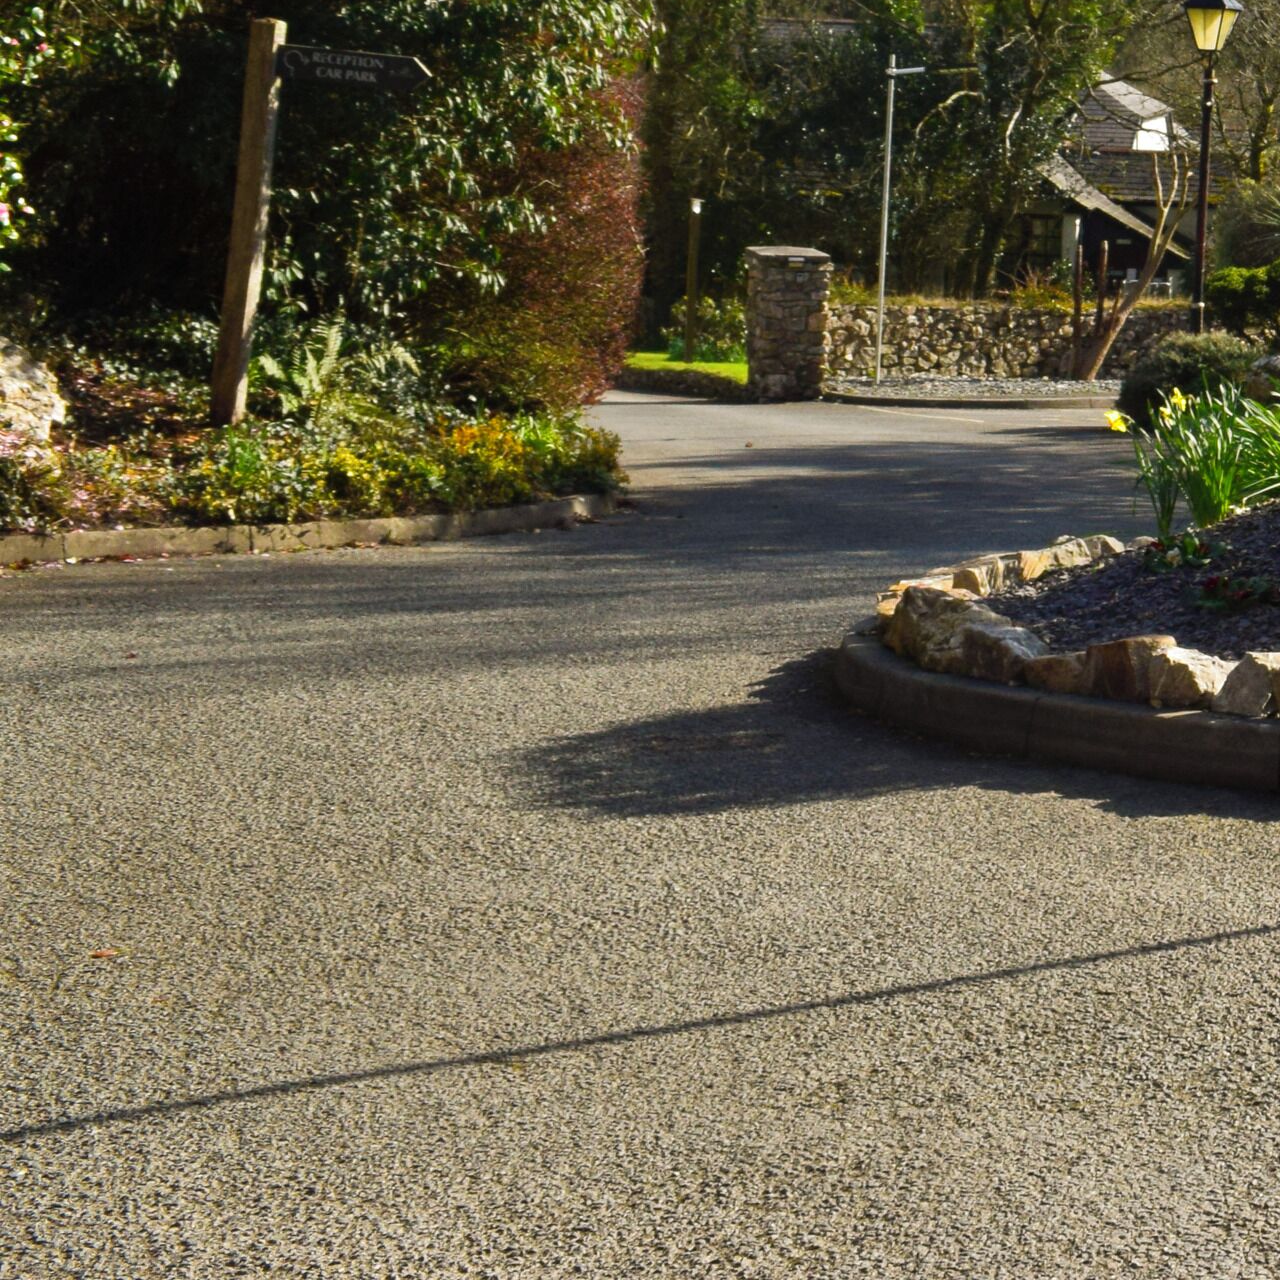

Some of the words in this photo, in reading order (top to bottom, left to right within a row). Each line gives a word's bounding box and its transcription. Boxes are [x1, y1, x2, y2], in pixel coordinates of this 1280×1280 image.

[311, 51, 384, 69] RECEPTION
[315, 66, 343, 80] CAR
[345, 69, 377, 83] PARK
